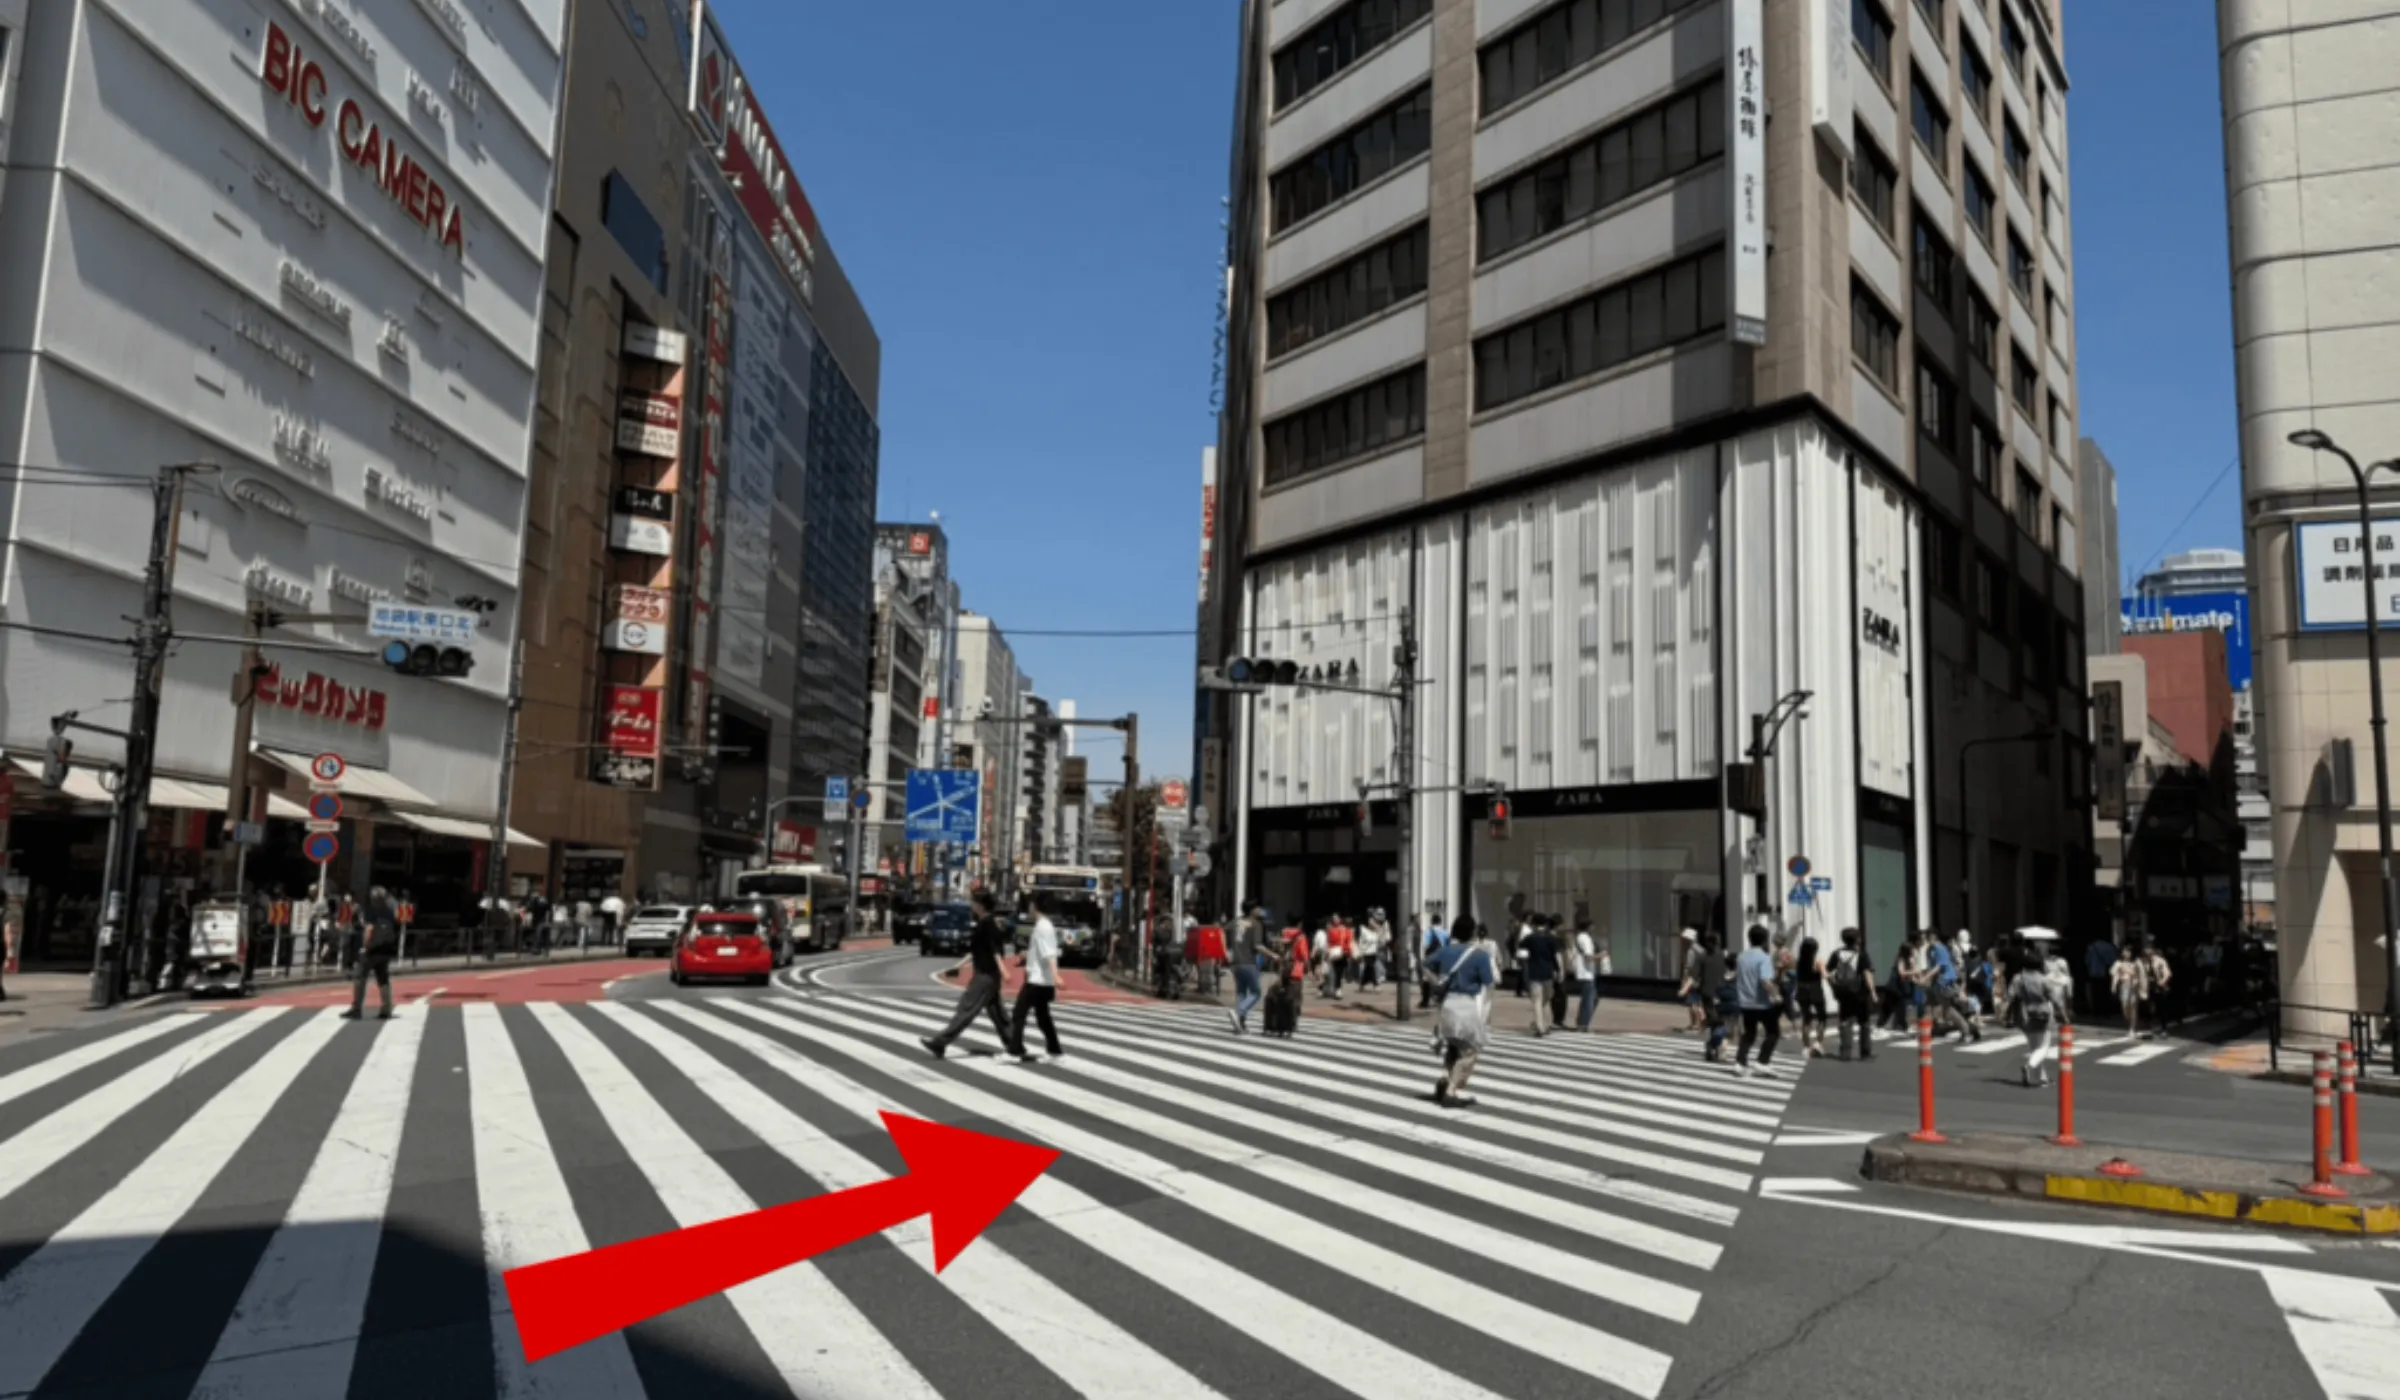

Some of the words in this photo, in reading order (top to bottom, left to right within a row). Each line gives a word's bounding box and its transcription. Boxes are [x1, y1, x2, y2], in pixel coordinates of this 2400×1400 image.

[265, 20, 327, 128] BIC
[339, 98, 463, 260] CAMERA
[1863, 606, 1899, 649] ZARA
[1298, 657, 1358, 680] ZARA
[257, 659, 387, 730] ビックカメラ
[1555, 792, 1603, 806] ZARA
